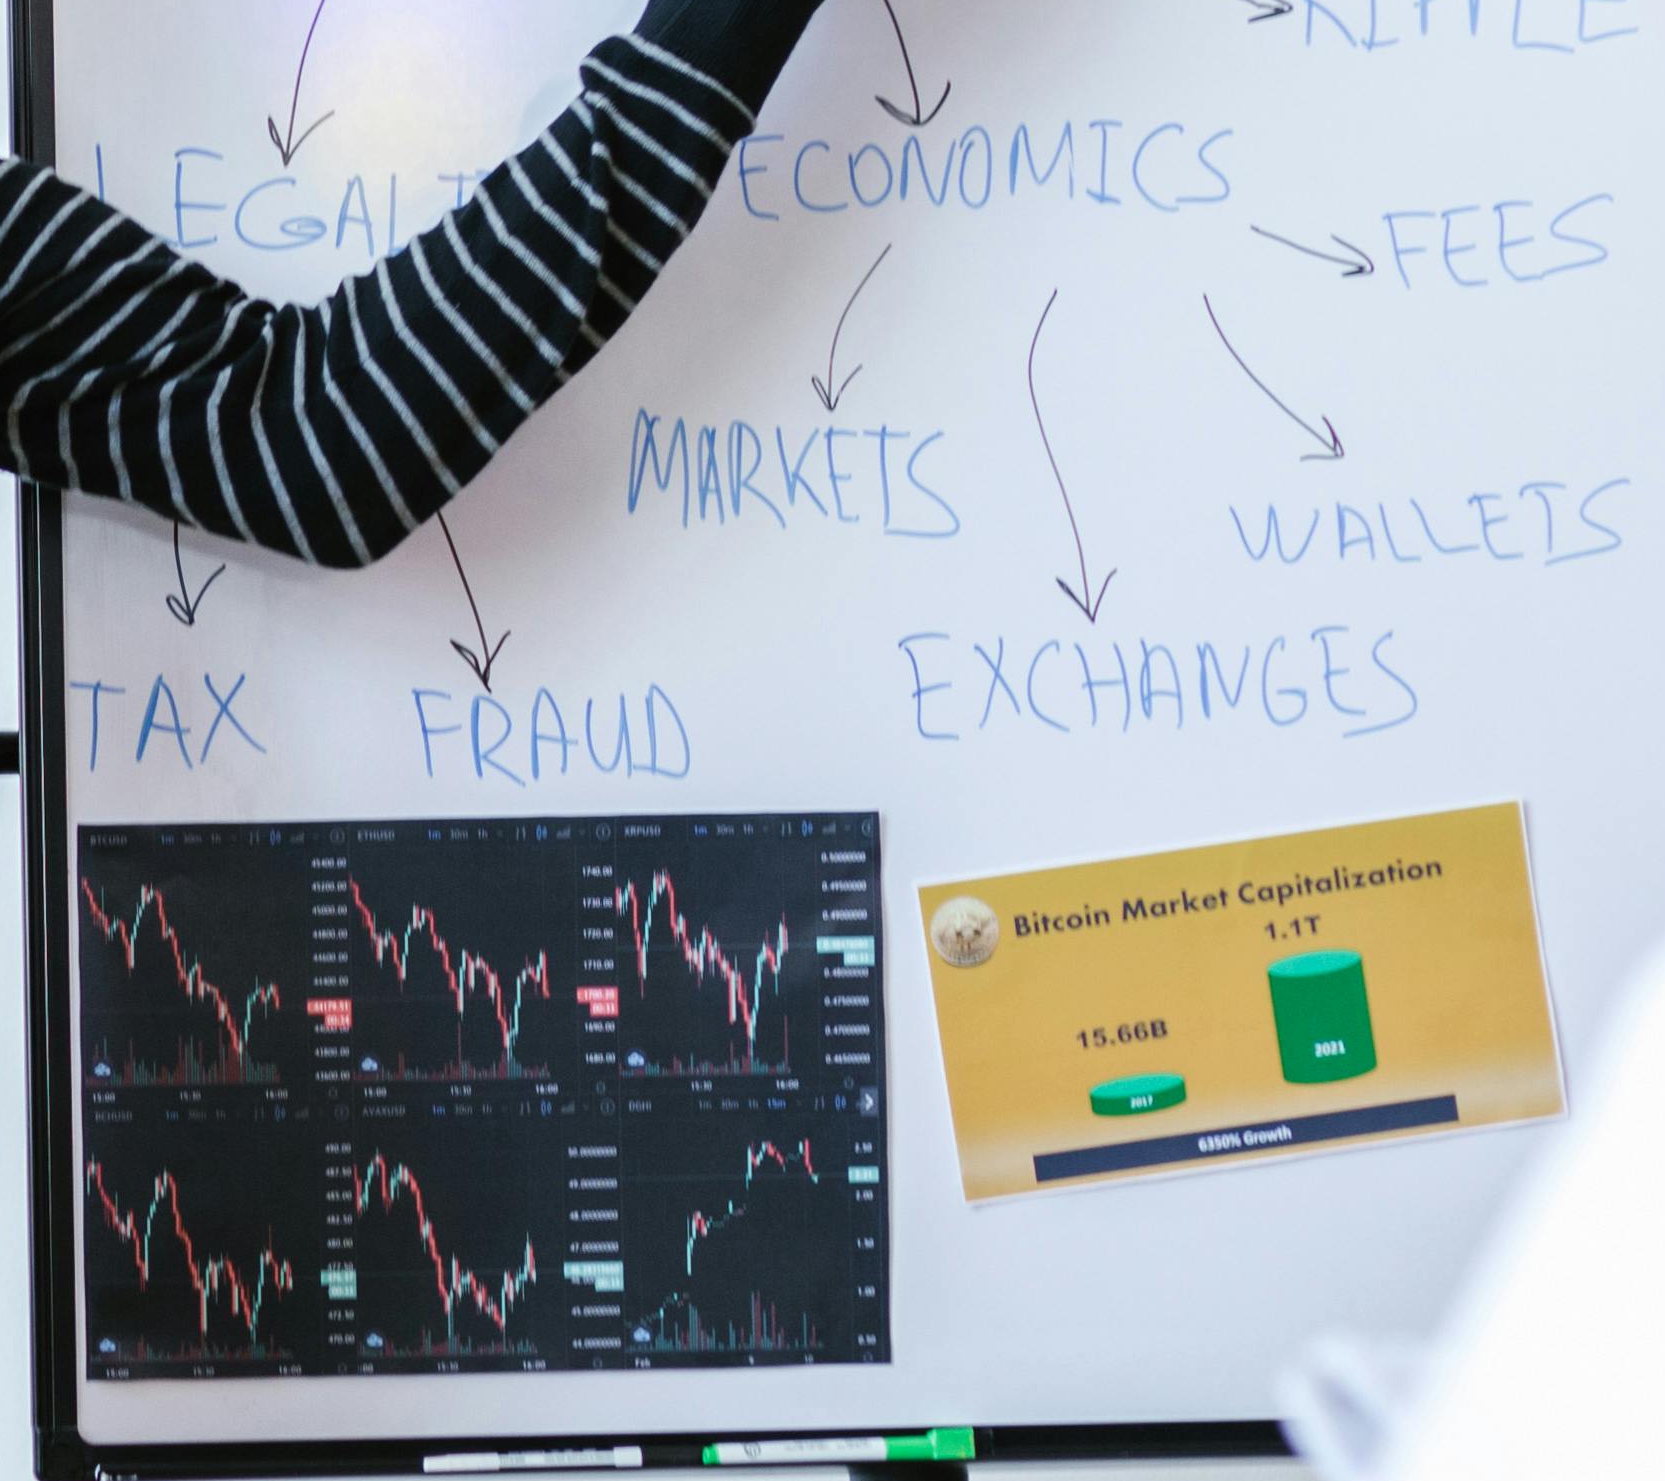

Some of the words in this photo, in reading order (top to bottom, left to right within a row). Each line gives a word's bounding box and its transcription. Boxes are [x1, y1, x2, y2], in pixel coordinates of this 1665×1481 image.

[741, 120, 1232, 220] ECONOMICS
[1382, 193, 1614, 289] FEES
[627, 408, 959, 537] MARKETS
[1230, 479, 1631, 566] WALLETS
[71, 672, 267, 772] TAX
[899, 626, 1418, 740] EXCHANGES
[412, 684, 692, 787] FRAUD
[1013, 908, 1110, 937] Bitcoin
[1122, 888, 1228, 921] Market
[1238, 857, 1443, 906] Capitalization
[1264, 917, 1321, 941] 1.1T
[1076, 1020, 1168, 1049] 15.66B
[1243, 1125, 1292, 1147] Growth
